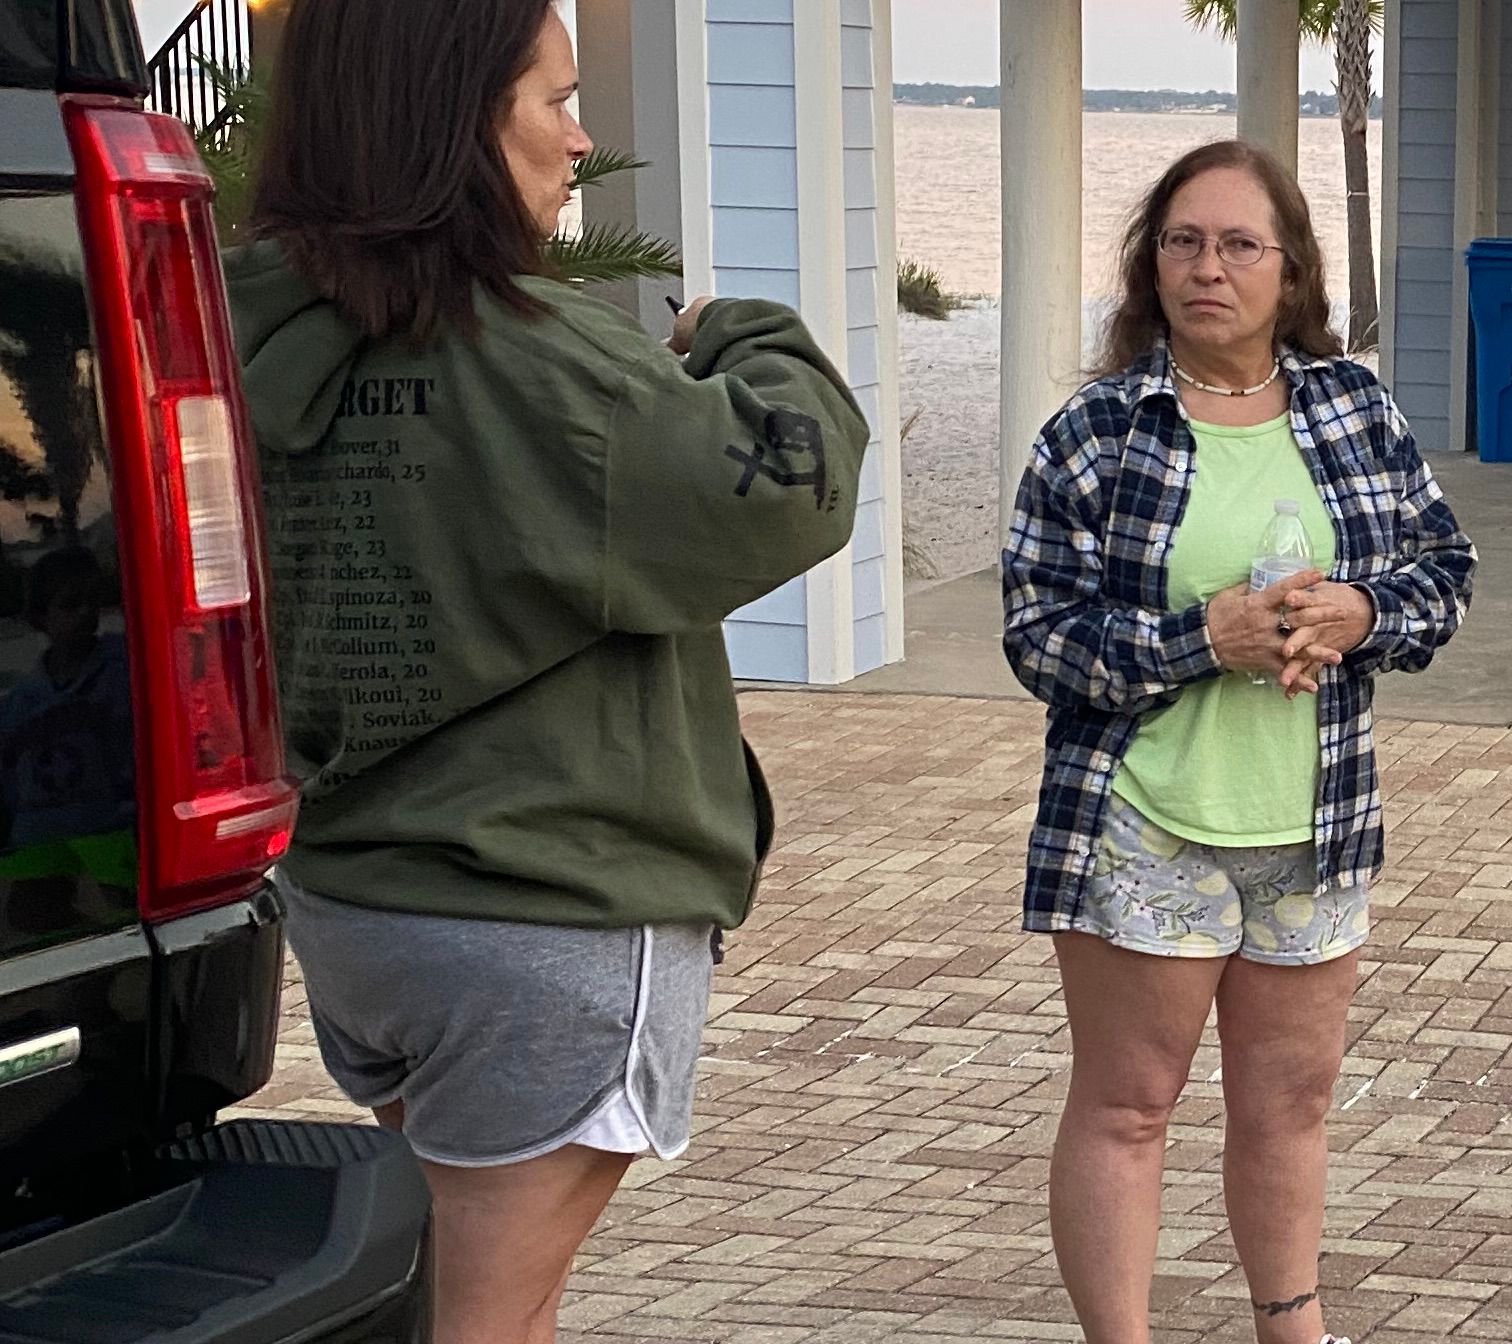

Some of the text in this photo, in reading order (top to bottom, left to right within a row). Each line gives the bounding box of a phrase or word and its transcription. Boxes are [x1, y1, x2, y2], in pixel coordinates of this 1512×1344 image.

[336, 377, 436, 418] RGET
[384, 439, 401, 458] 31
[400, 463, 427, 482] 25
[350, 489, 373, 508] 23
[354, 515, 376, 530] 22
[366, 538, 387, 559] 23
[393, 565, 413, 582] 22
[328, 587, 405, 611] spinoza,
[411, 589, 434, 606] 20
[330, 611, 398, 634] chmitz,
[405, 614, 428, 630] 20
[412, 638, 437, 655] 20
[334, 663, 397, 682] erola,
[403, 663, 429, 680] 20
[417, 687, 443, 704] 20
